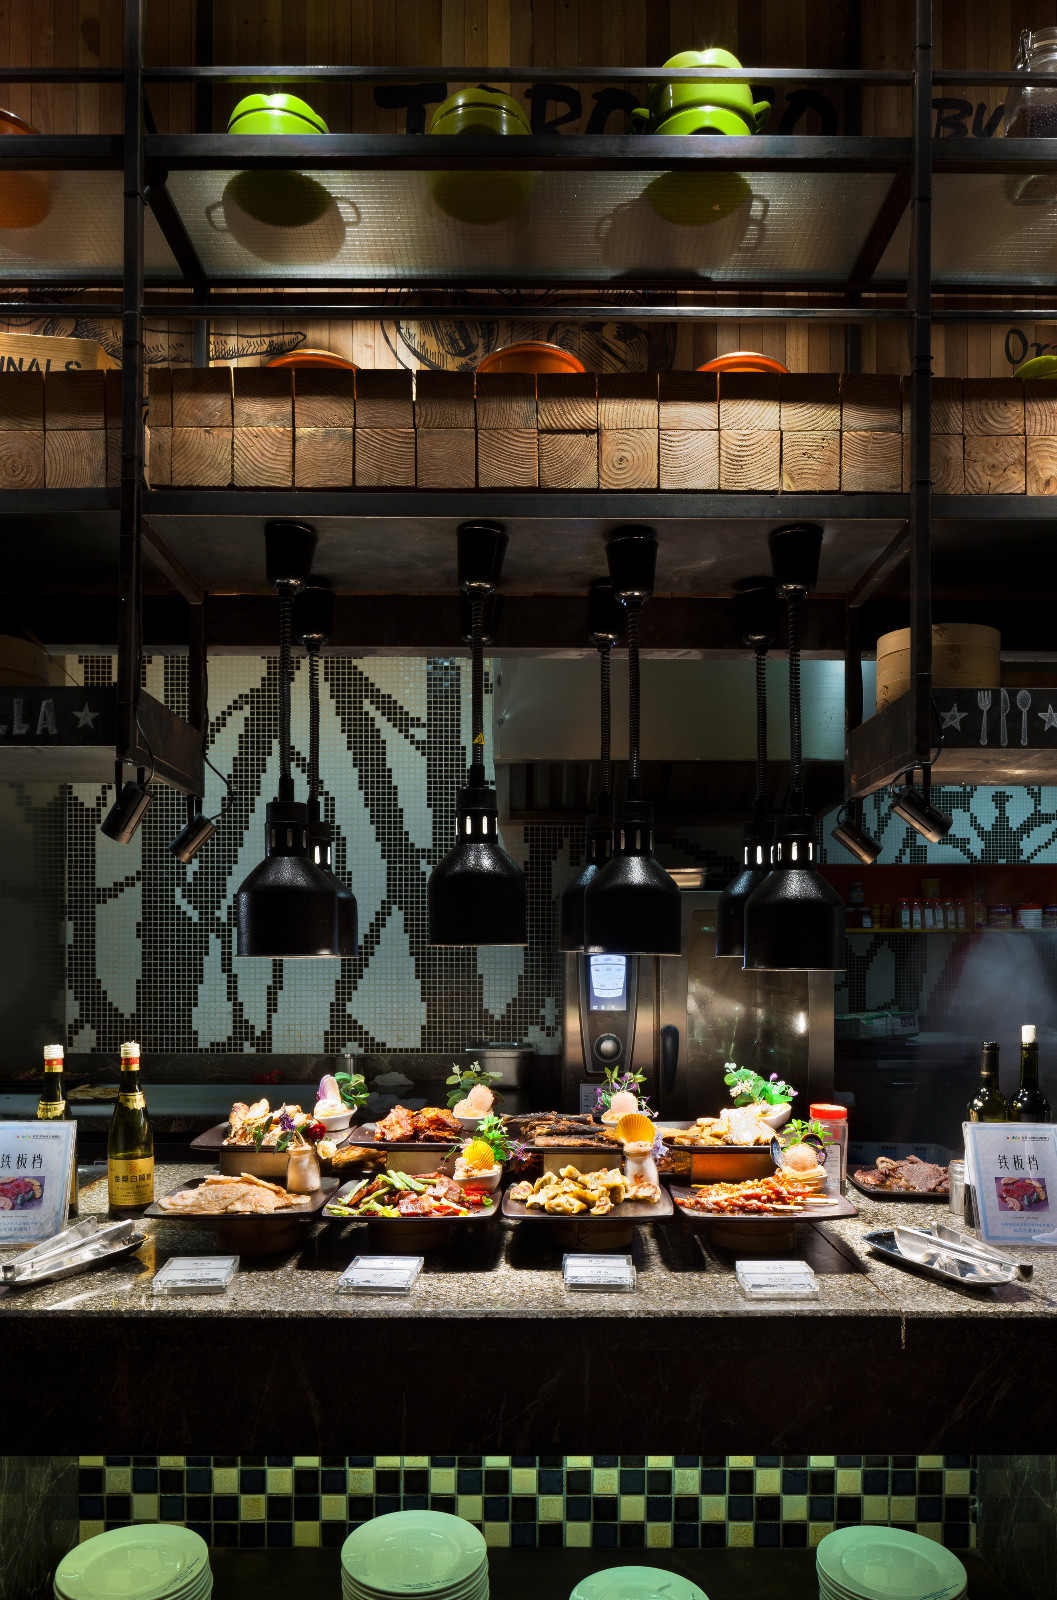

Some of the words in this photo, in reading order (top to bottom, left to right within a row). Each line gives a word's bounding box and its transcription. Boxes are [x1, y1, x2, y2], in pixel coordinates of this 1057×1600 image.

[0, 1153, 43, 1170] 铁板档
[997, 1154, 1040, 1171] 铁板档
